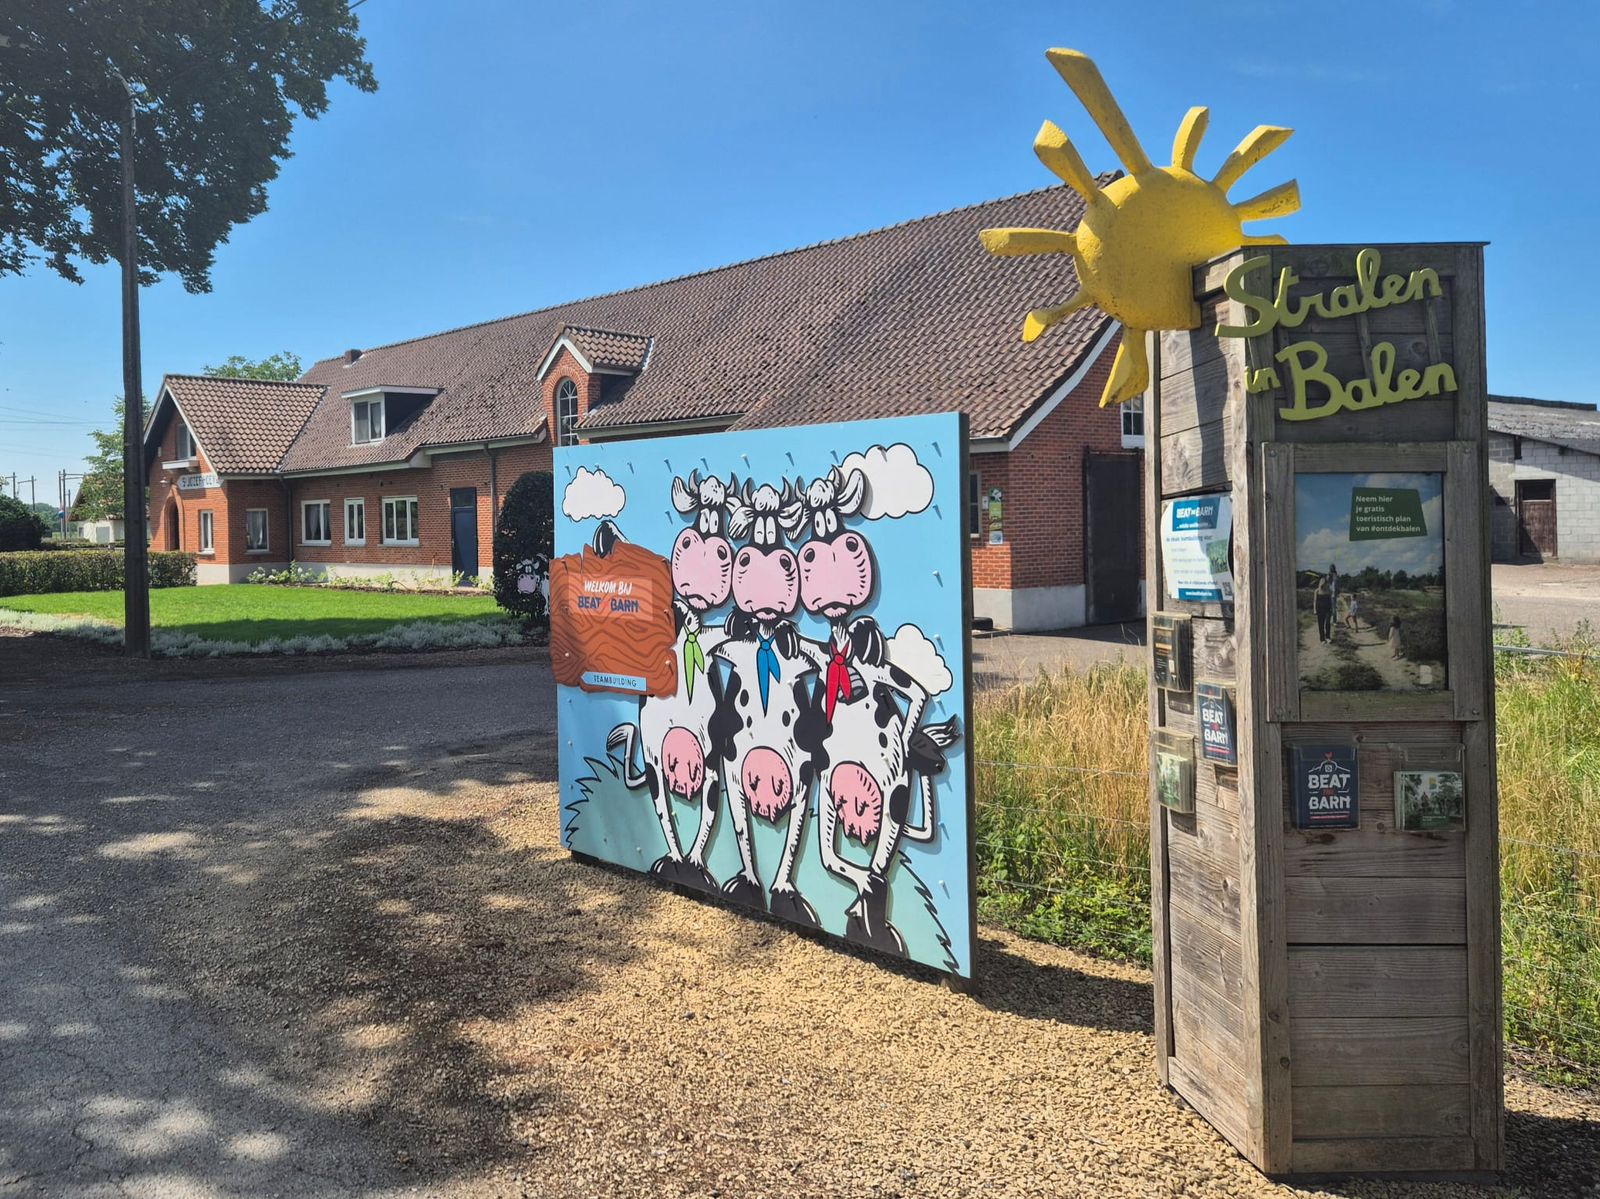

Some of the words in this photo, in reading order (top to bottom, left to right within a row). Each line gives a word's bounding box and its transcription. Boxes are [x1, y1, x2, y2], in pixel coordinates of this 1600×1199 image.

[1215, 248, 1443, 338] Stralen
[1244, 366, 1281, 394] in
[1275, 341, 1458, 421] Balen
[1355, 505, 1363, 513] je
[1364, 505, 1385, 513] gratis
[1356, 514, 1394, 522] toeristisch
[1395, 514, 1412, 524] plan
[1371, 525, 1421, 533] #ontdekbalen
[584, 581, 616, 592] WELKOM
[617, 581, 633, 595] BIJ
[578, 596, 601, 608] BEAT
[611, 599, 638, 612] BARN
[593, 675, 637, 687] TEAMBUILDING
[1202, 708, 1224, 724] BEAT
[1204, 728, 1228, 745] BARN
[1308, 773, 1351, 789] BEAT
[1308, 795, 1351, 809] BARN
